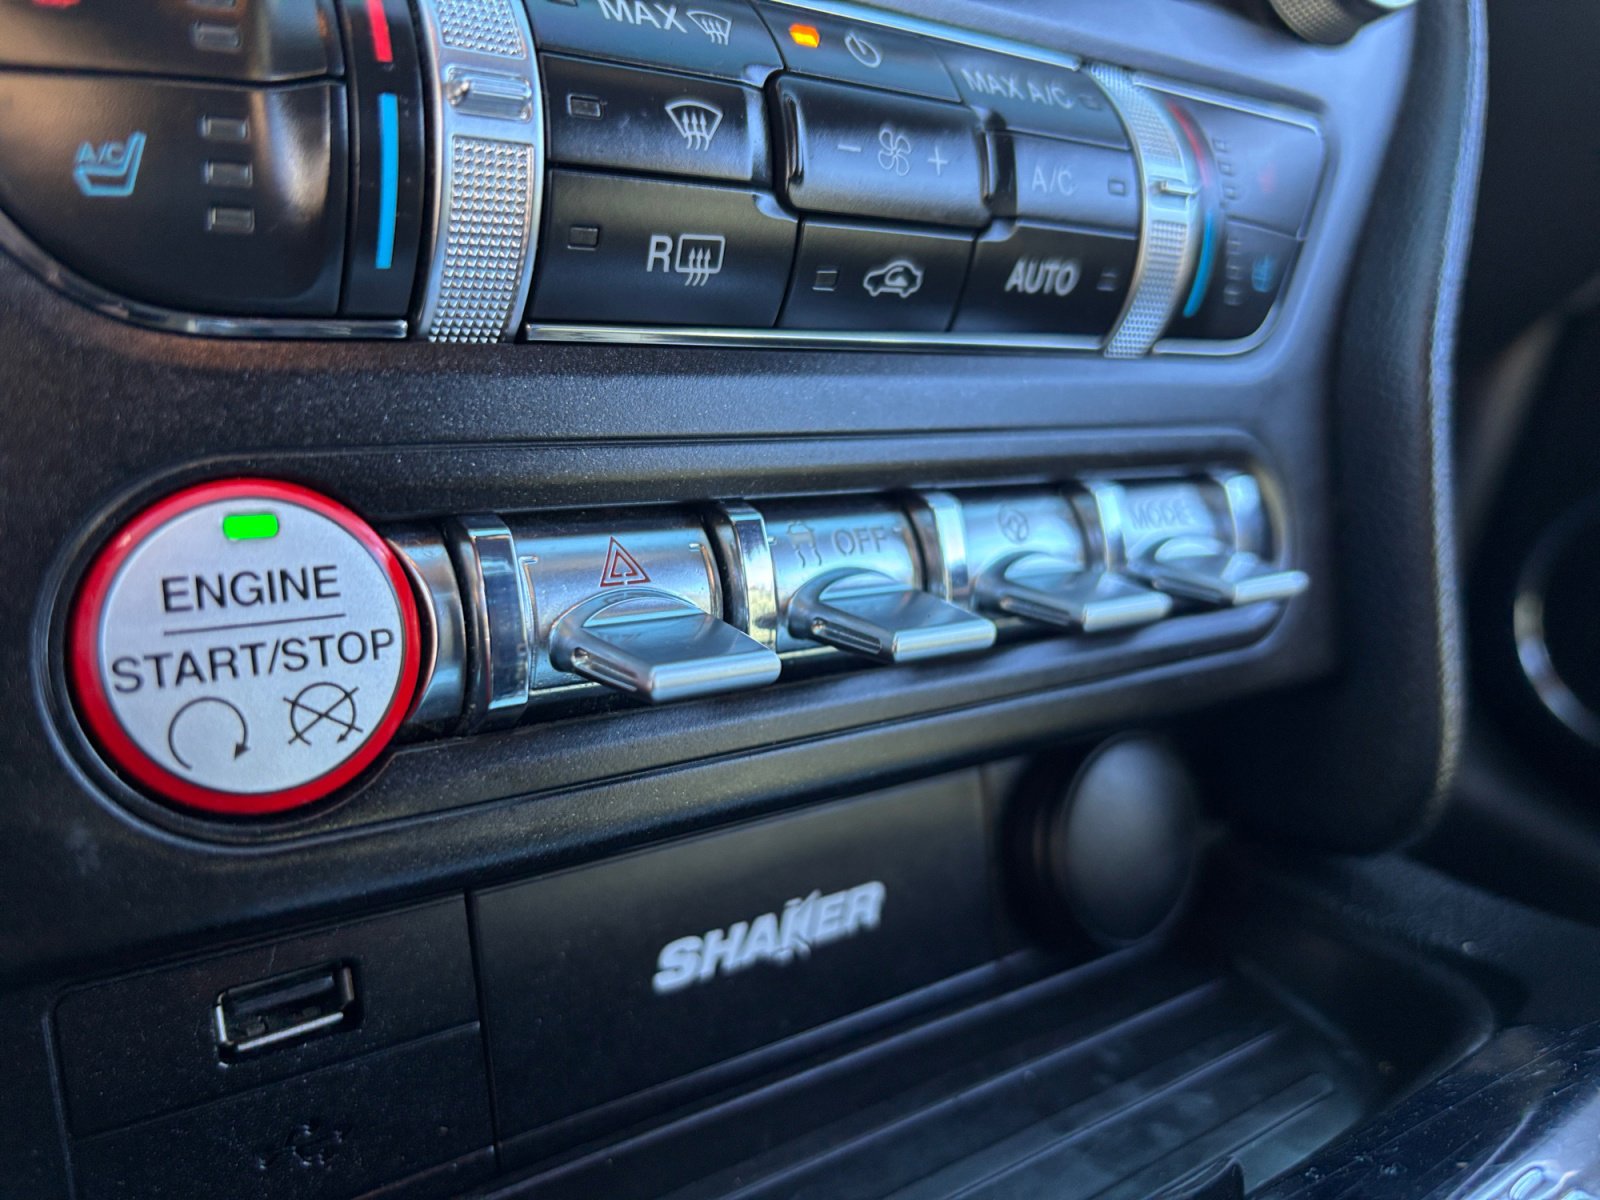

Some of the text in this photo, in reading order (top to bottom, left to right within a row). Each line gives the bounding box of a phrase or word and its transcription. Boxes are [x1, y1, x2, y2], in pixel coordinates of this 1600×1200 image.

[597, 0, 687, 34] MAX
[961, 68, 1073, 109] MAX A/C
[76, 141, 124, 163] A/C
[1030, 164, 1076, 196] A/C
[646, 234, 673, 273] R
[1004, 256, 1082, 297] AUTO
[1130, 500, 1191, 530] MODE
[832, 526, 886, 556] OFF
[161, 565, 341, 613] ENGINE
[111, 628, 394, 694] START/STOP
[651, 880, 887, 994] SHAKER
